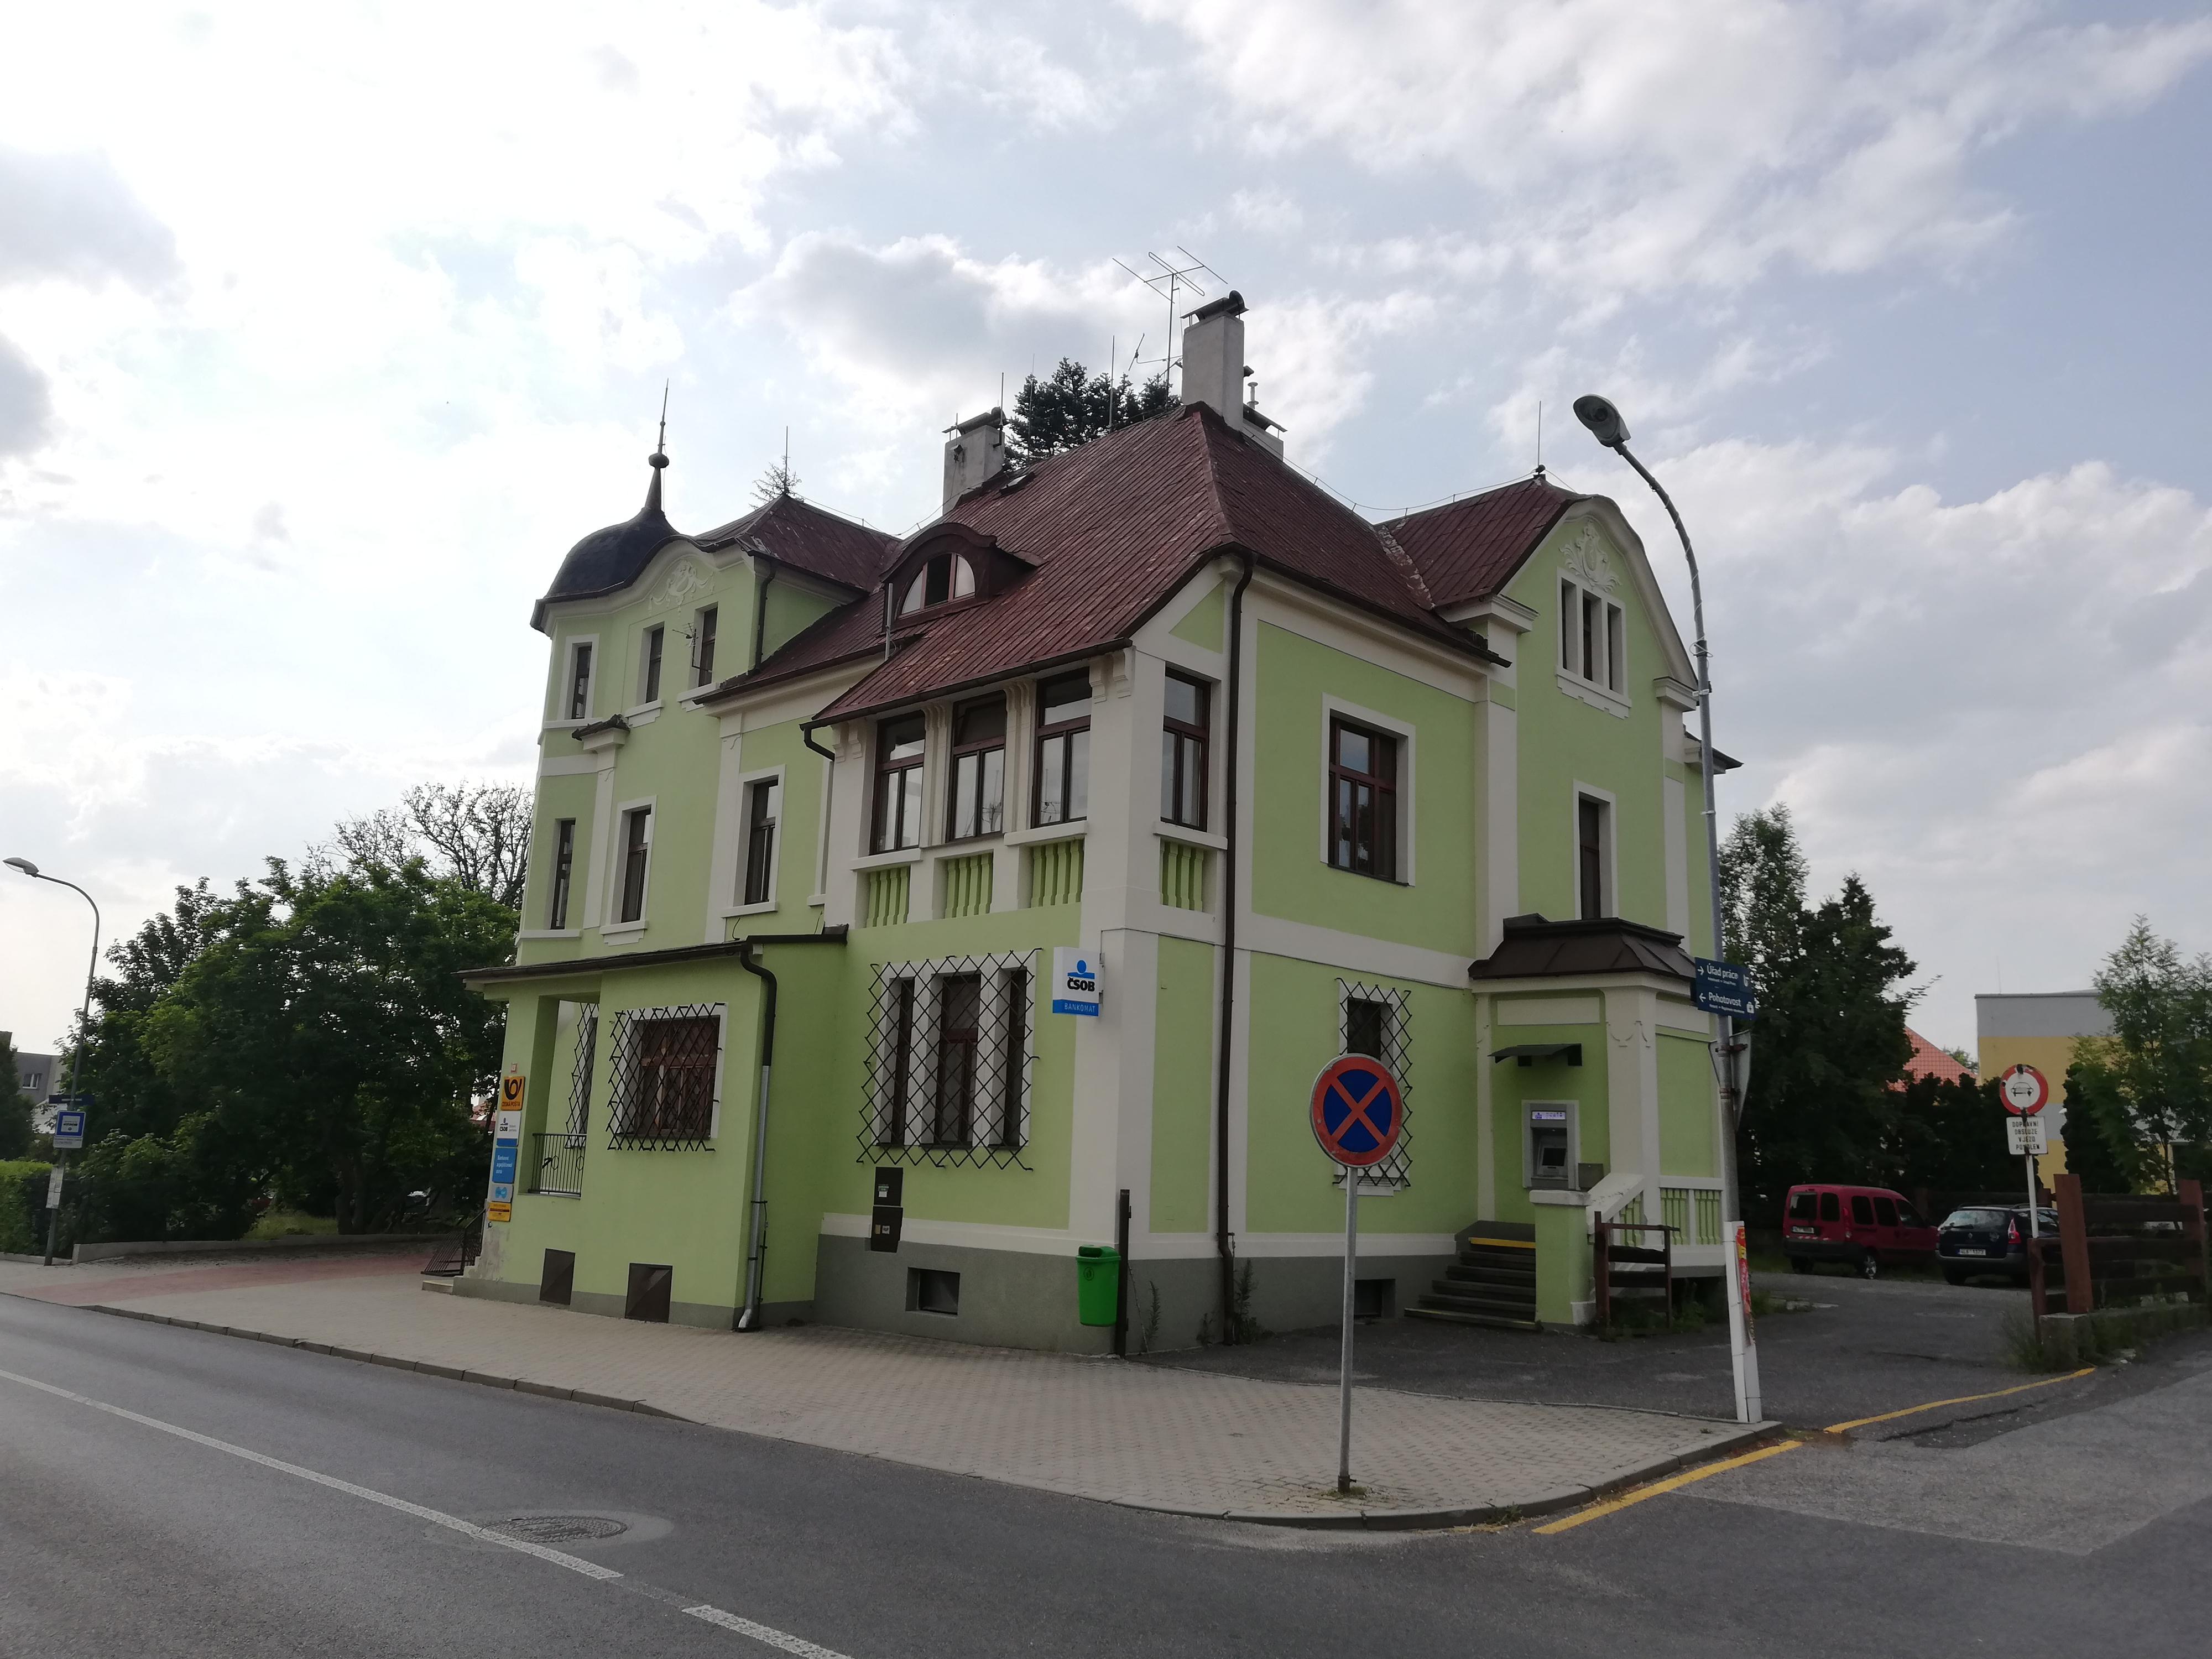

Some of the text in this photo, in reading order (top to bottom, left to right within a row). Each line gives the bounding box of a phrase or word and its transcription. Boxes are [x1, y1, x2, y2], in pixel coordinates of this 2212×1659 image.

[1722, 969, 1739, 979] práce
[1067, 977, 1095, 992] ČSOB
[1709, 992, 1742, 1007] Pohotovost
[1065, 1003, 1095, 1013] BANKOMAT
